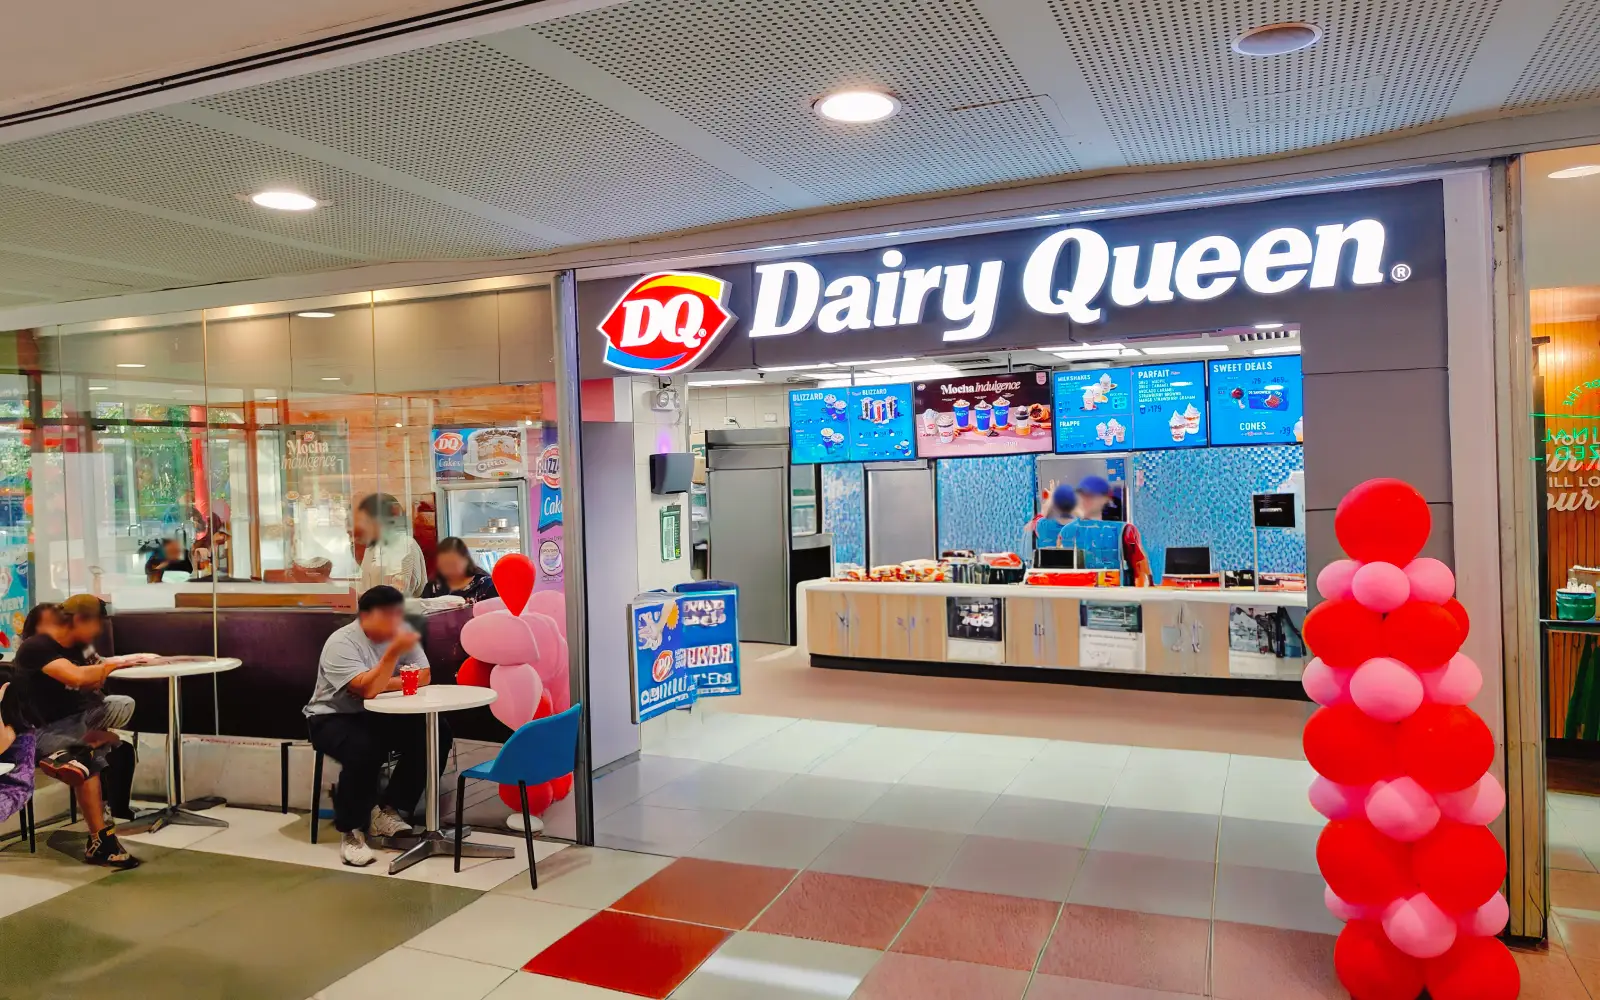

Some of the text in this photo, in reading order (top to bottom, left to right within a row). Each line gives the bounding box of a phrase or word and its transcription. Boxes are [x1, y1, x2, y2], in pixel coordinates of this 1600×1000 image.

[748, 249, 1004, 342] Dairy
[1022, 218, 1385, 324] Queen
[620, 293, 705, 349] DQ
[1213, 361, 1273, 373] SWEET DEALS
[1138, 369, 1170, 379] PARFAIT
[861, 388, 888, 397] BLIZZARD
[940, 383, 975, 395] Mocha
[974, 380, 1021, 394] Indulgence
[792, 392, 825, 402] BLIZZARD
[1239, 421, 1267, 431] CONES
[439, 438, 459, 450] DQ
[1550, 434, 1587, 445] YOU
[286, 440, 329, 455] Mocha
[281, 454, 337, 472] Indulgence
[438, 457, 461, 468] Cakes
[476, 459, 507, 473] OREO
